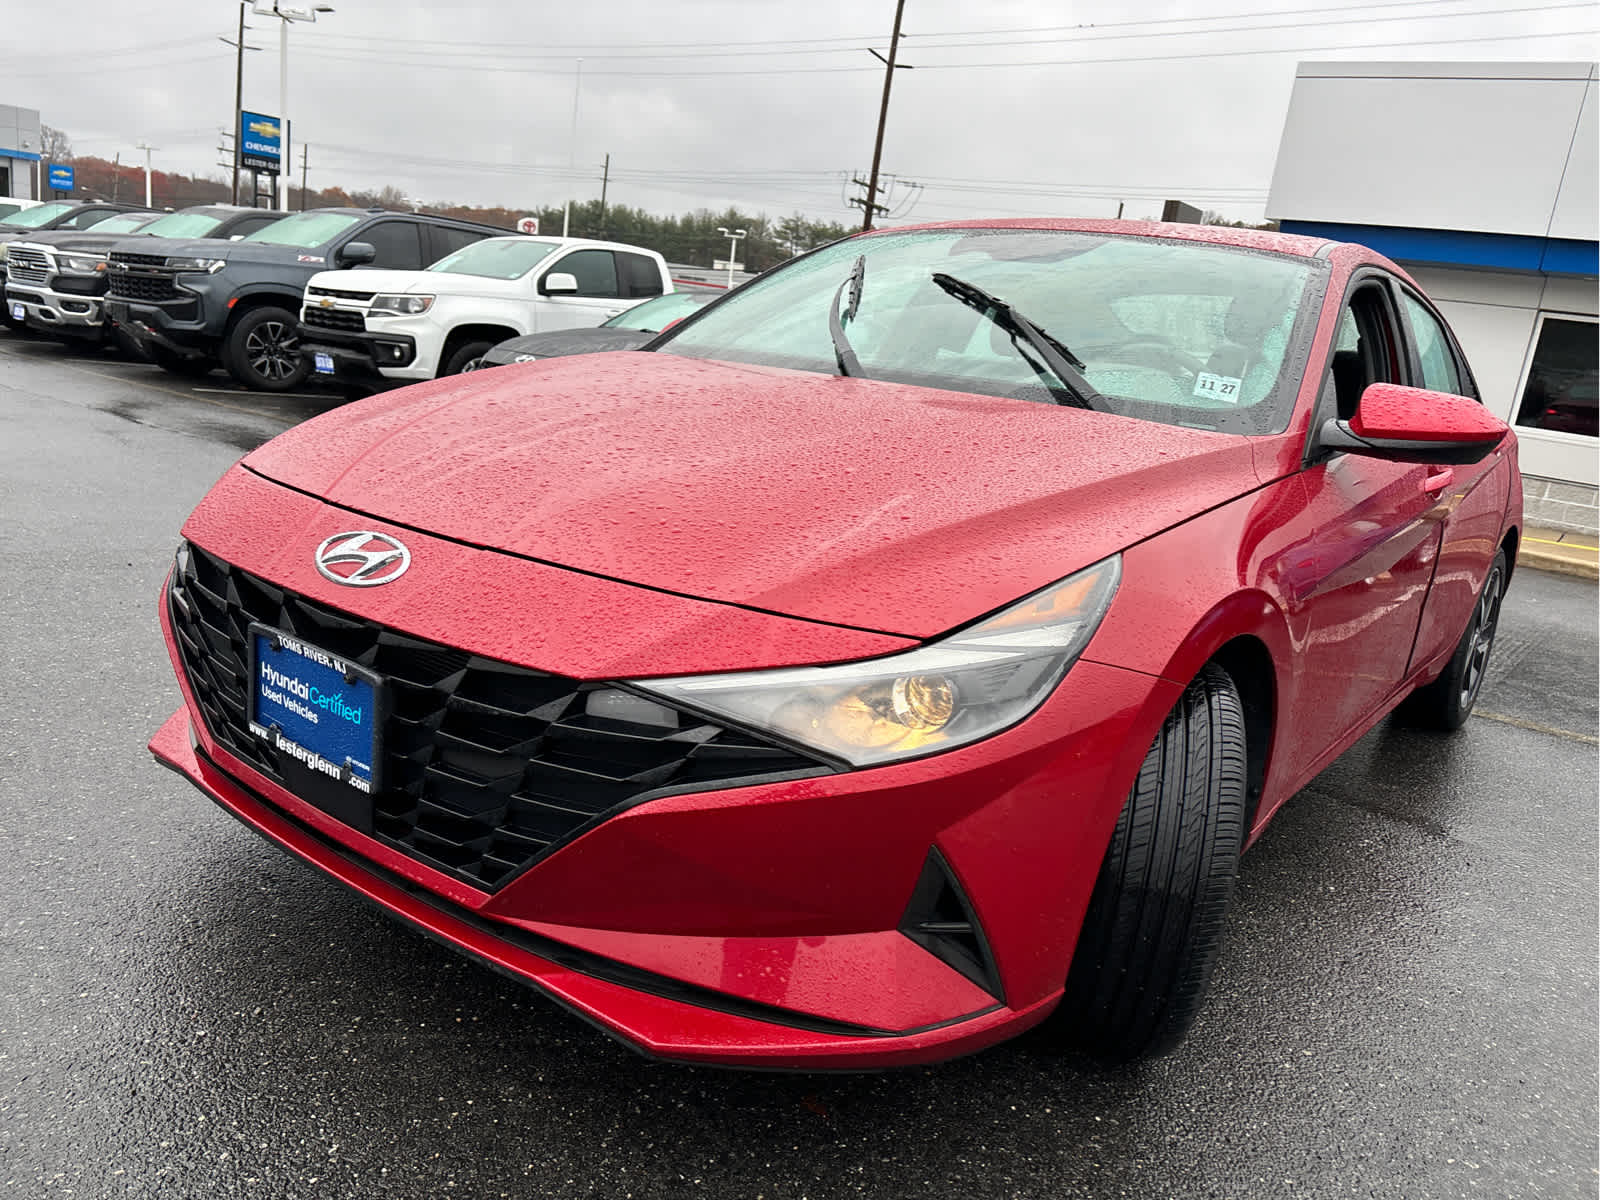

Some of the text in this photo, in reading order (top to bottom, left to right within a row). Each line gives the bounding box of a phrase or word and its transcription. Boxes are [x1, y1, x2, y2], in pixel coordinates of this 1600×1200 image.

[1220, 383, 1236, 394] 27
[277, 635, 303, 655] TOMS
[334, 659, 346, 674] NJ
[261, 661, 361, 724] Hyundai Certified
[261, 684, 319, 724] Used Vehicles
